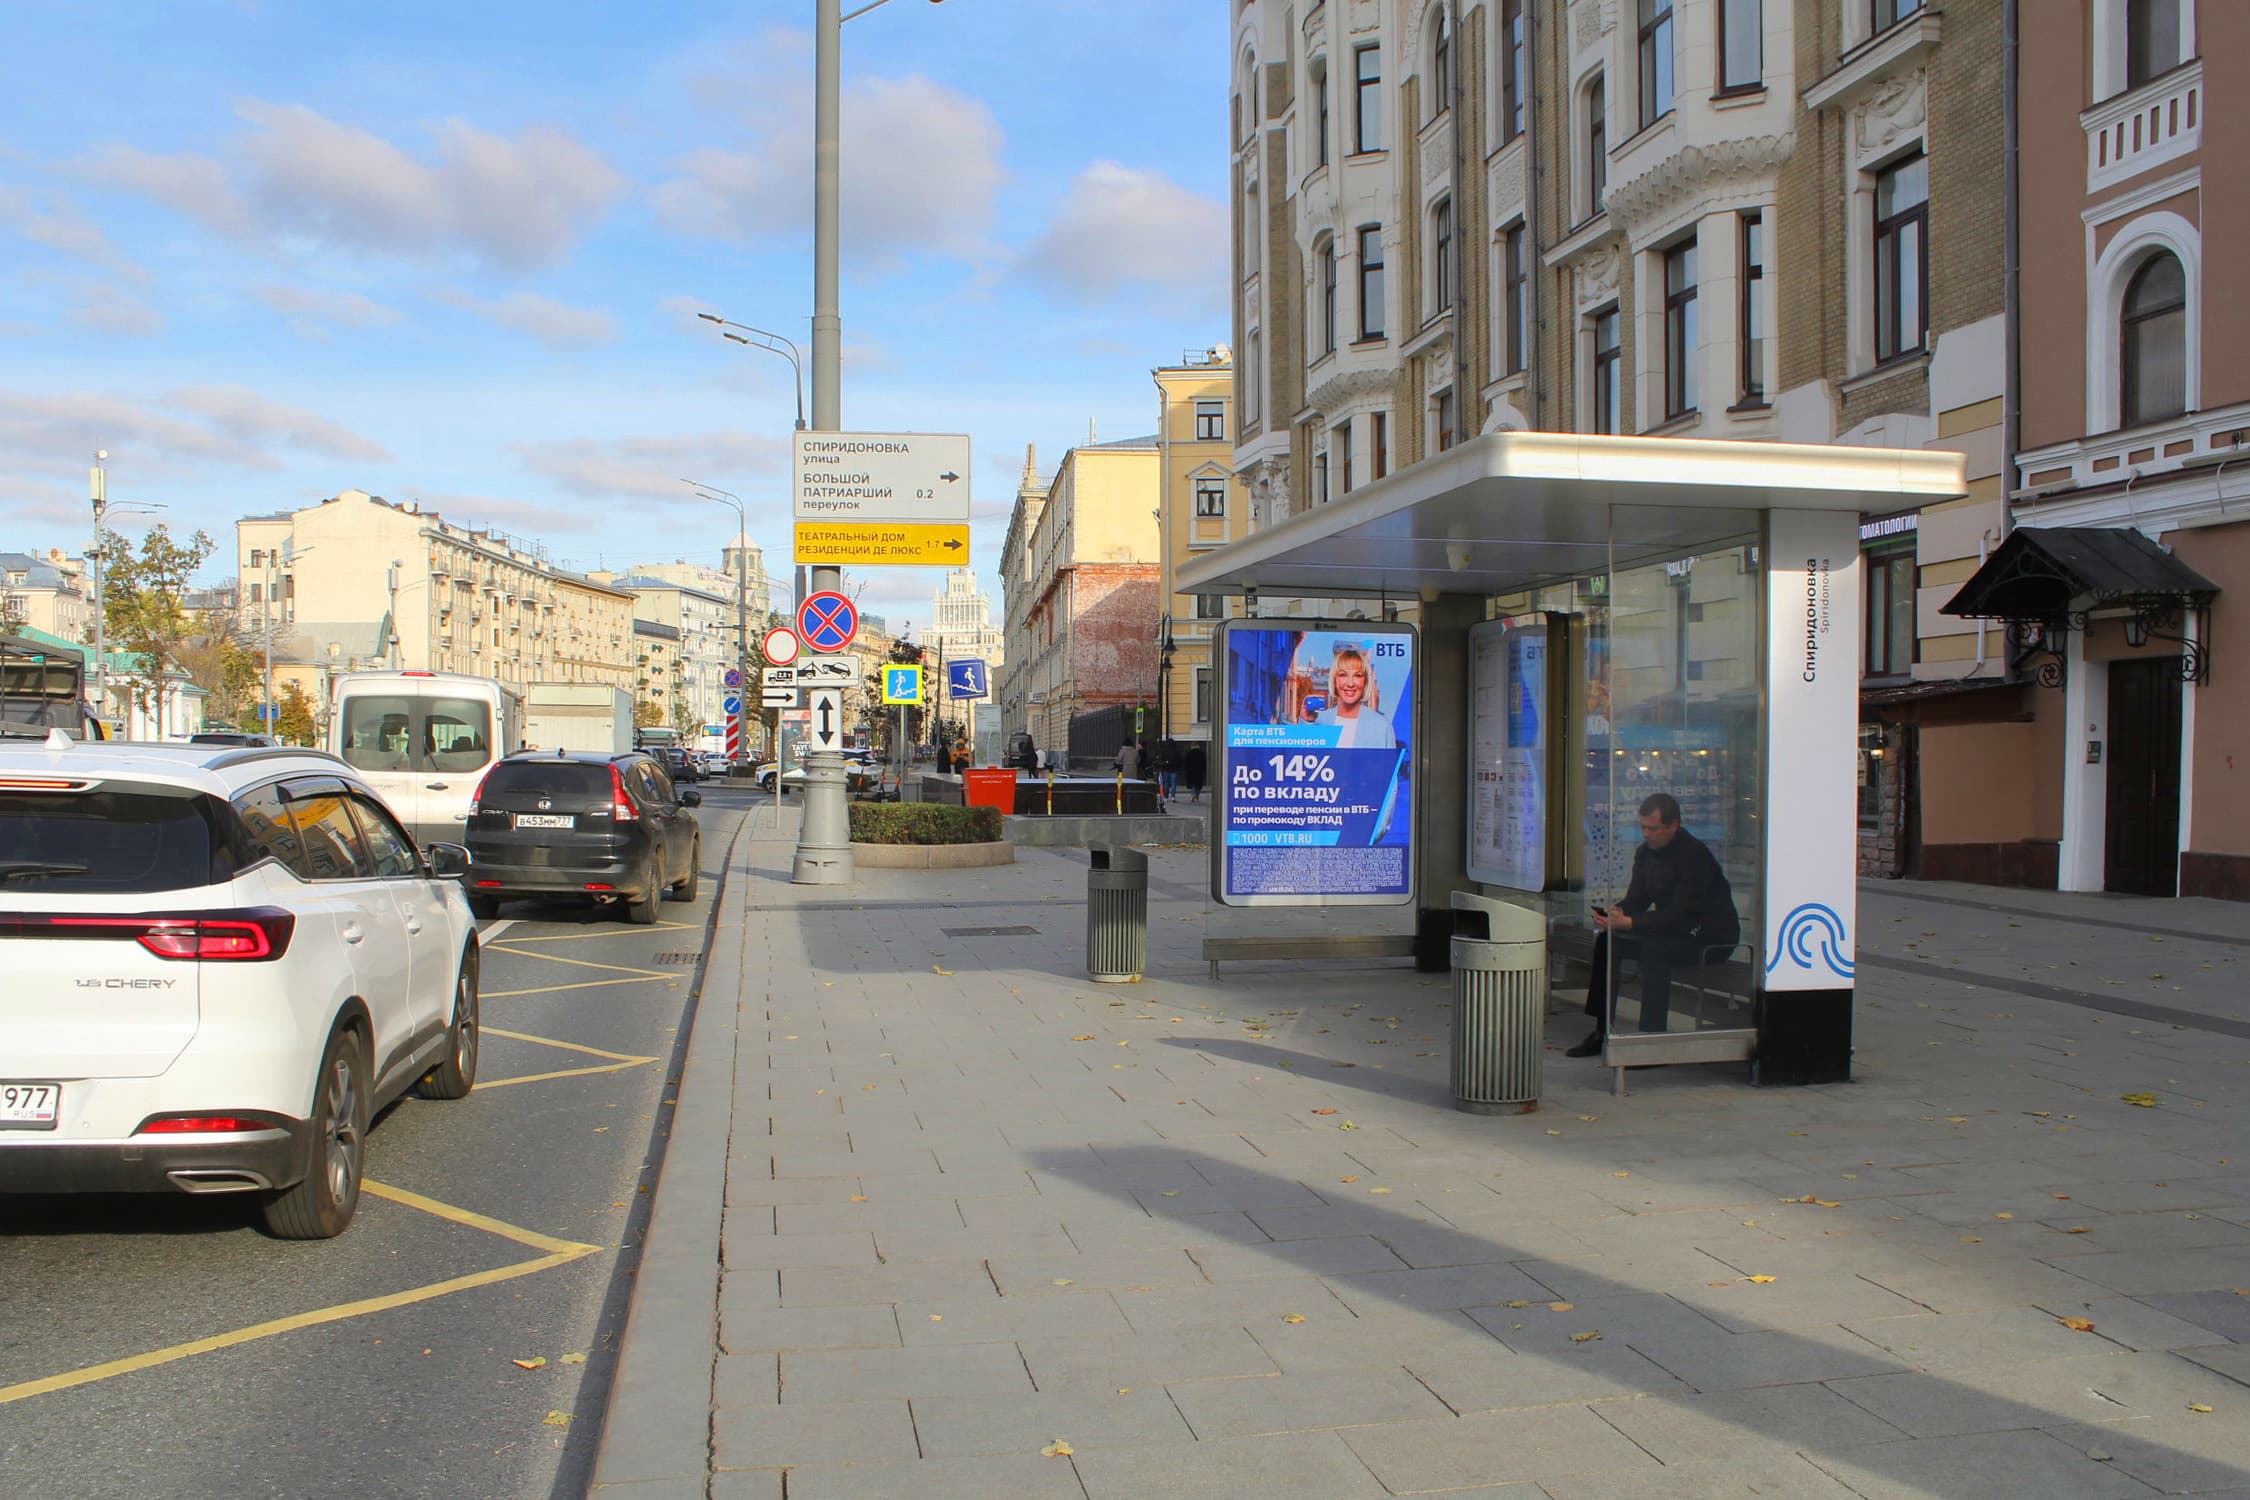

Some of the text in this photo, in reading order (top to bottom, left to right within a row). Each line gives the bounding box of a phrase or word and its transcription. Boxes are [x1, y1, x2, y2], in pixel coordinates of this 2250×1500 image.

[803, 442, 910, 454] СПИРИДОНОВКА
[803, 455, 840, 465] улица
[803, 472, 870, 484] БОЛЬШОЙ
[803, 487, 893, 498] ПАТРИАРШИЙ
[916, 489, 934, 499] 0.2
[803, 501, 860, 511] переулок
[1859, 514, 1918, 540] ТОМАТОЛОГИИ
[799, 531, 905, 543] ТЕАТРАЛЬНЫЙ ДОМ
[798, 545, 922, 556] РЕЗИДЕНЦИИ ДЕ ЛЮКС
[1820, 558, 1832, 634] Spiridonovka
[1803, 559, 1818, 682] Спиридоновка
[1376, 643, 1405, 658] ВТБ
[1233, 727, 1286, 738] Карта ВТБ
[1233, 738, 1326, 748] для пенсионеров
[1233, 754, 1335, 784] До 14%
[1233, 786, 1341, 803] по вкладу
[1233, 806, 1254, 815] при
[1254, 806, 1305, 816] переводе
[1305, 806, 1343, 814] пенсии
[1343, 806, 1350, 814] в
[1351, 805, 1369, 814] ВТБ
[1233, 815, 1343, 826] по промокоду ВКЛАД
[1241, 833, 1312, 843] 1000 VTB.RU
[105, 978, 177, 989] CHERY
[5, 1087, 49, 1109] 977
